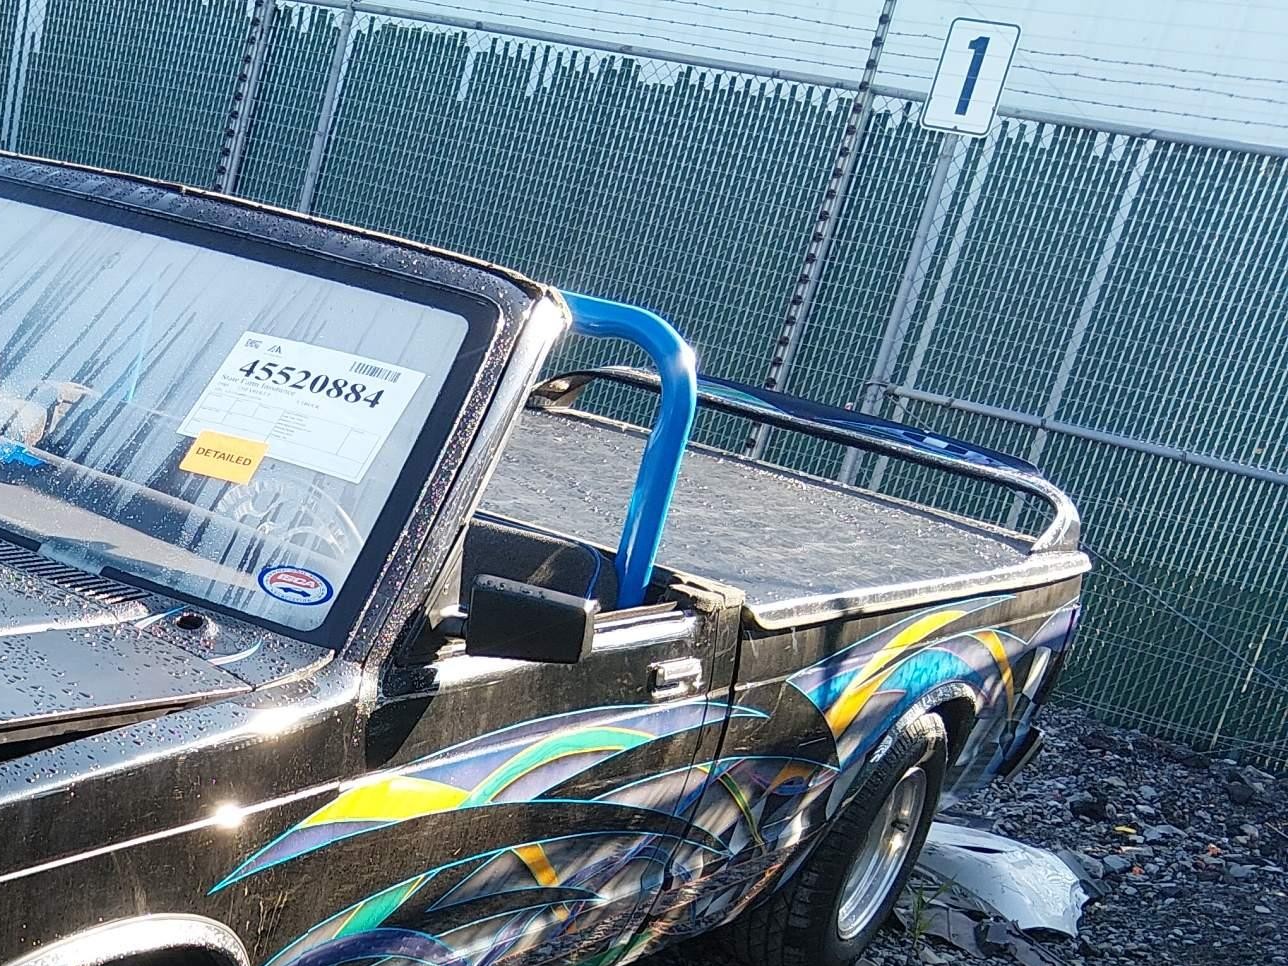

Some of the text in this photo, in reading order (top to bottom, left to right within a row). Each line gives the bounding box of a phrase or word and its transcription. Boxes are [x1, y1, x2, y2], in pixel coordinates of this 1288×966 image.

[955, 36, 990, 116] 1
[239, 359, 385, 409] 45520884
[195, 447, 253, 467] DETAILED
